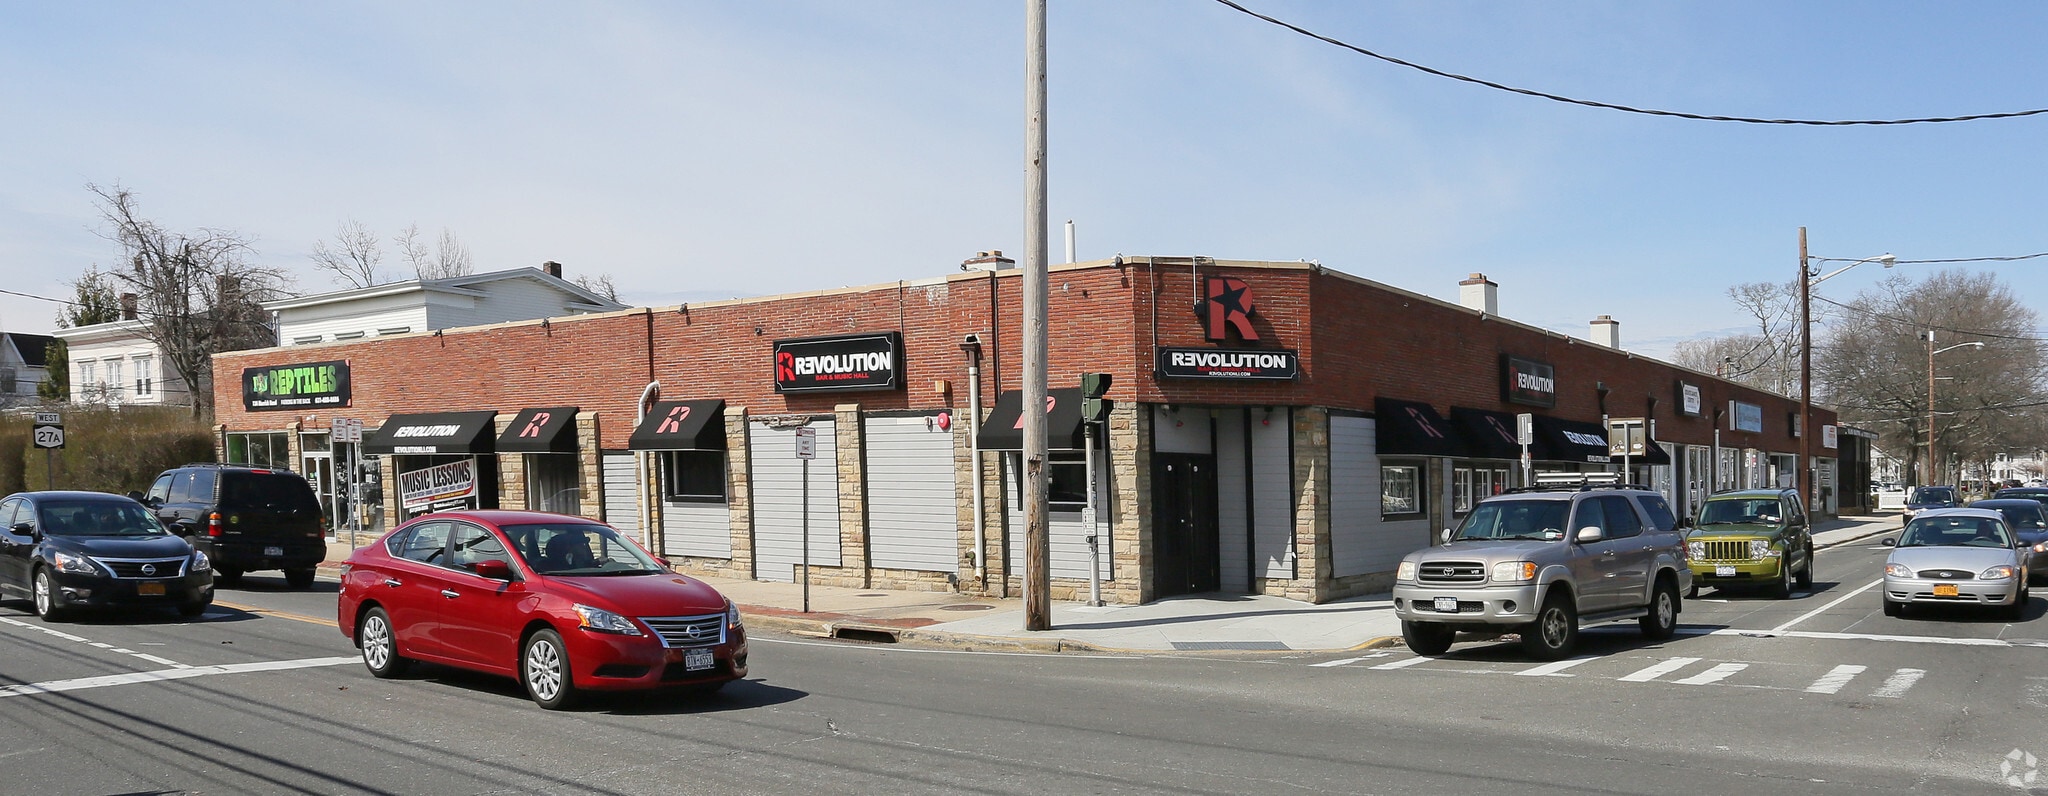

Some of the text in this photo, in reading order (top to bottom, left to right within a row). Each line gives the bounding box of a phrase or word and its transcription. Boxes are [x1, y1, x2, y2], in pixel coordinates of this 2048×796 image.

[795, 351, 891, 375] REVOLUTION
[1171, 352, 1286, 369] REVOLUTION
[269, 365, 336, 396] REPTILES
[1518, 372, 1554, 394] REVOLUTION
[38, 414, 58, 422] WEST
[519, 412, 551, 438] R
[656, 406, 691, 434] R
[38, 431, 61, 442] 27A
[393, 425, 461, 438] REVOLUTION
[401, 469, 430, 494] MUSIC
[432, 461, 471, 487] LESSONS
